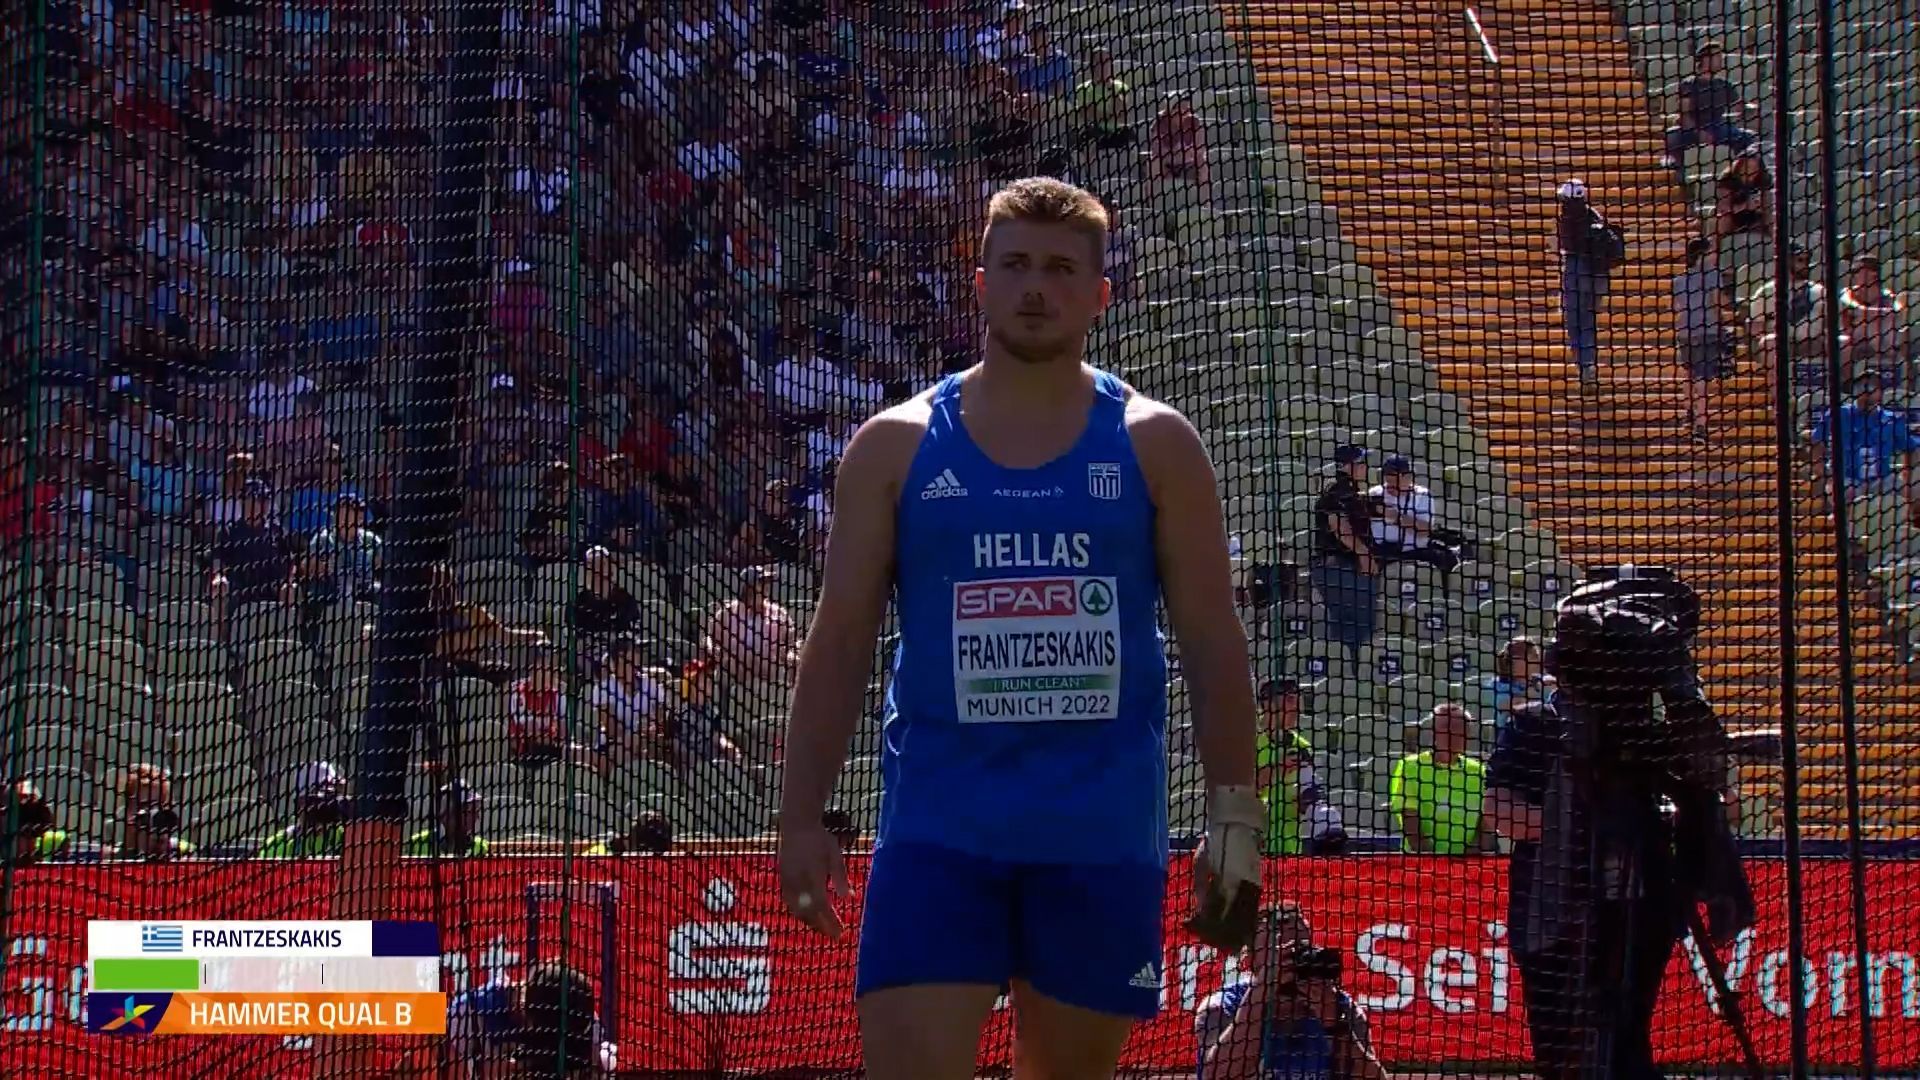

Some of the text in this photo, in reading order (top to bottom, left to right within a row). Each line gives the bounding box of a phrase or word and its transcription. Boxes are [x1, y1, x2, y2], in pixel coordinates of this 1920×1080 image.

[921, 486, 968, 500] adidas
[992, 488, 1051, 498] AEGEAN
[973, 532, 1090, 568] HELLAS
[960, 584, 1074, 614] SPAR
[957, 630, 1116, 671] FRANTZESKAKIS
[1001, 679, 1031, 691] RUN
[1035, 677, 1080, 689] CLEAN
[967, 695, 1110, 717] MUNICH 2022
[1356, 922, 1509, 1013] Sei
